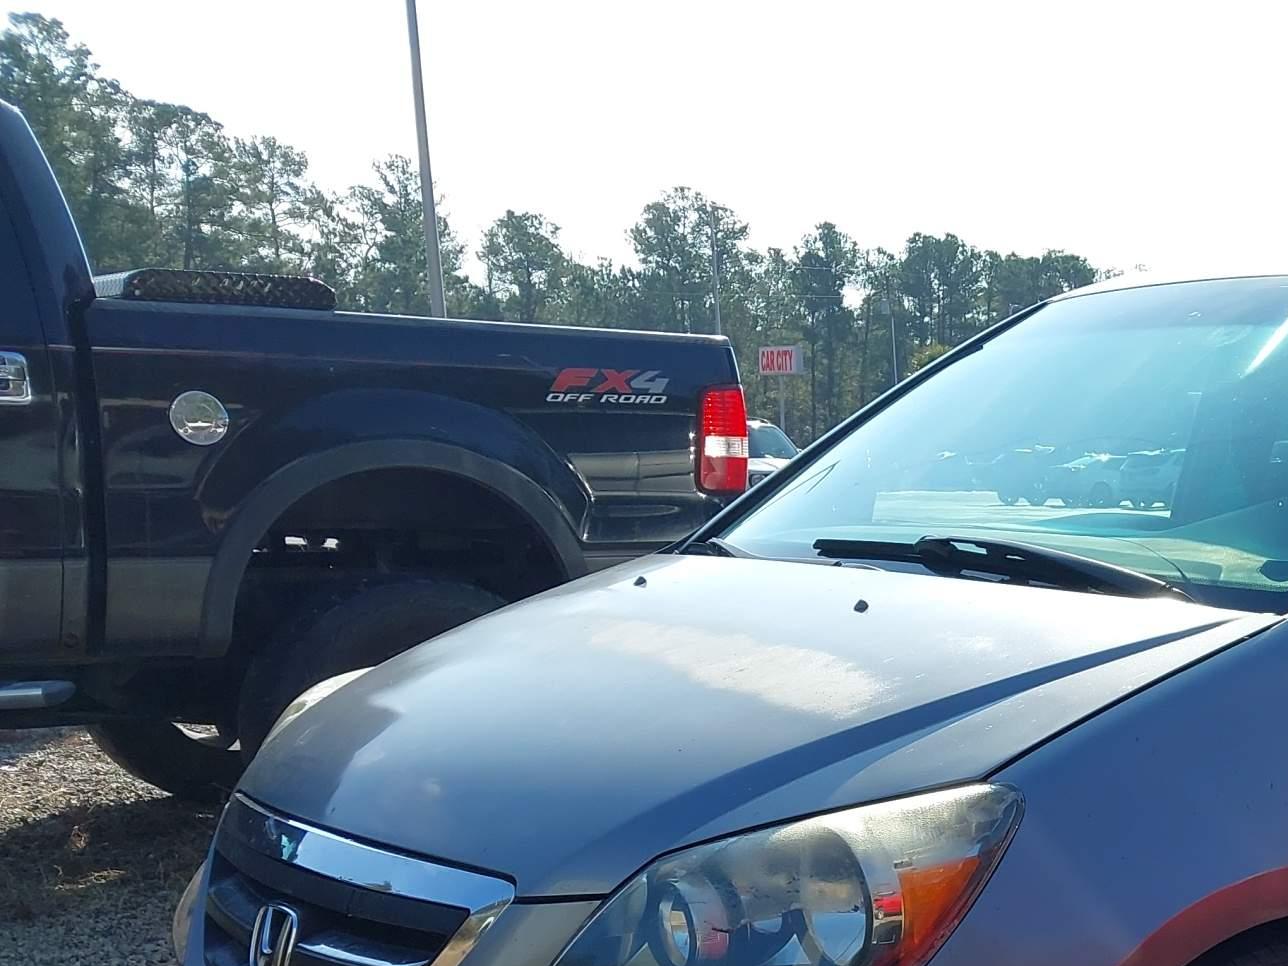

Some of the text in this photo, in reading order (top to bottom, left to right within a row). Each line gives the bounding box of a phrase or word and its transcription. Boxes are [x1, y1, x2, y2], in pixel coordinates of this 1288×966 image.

[761, 350, 792, 371] CAR CITY
[550, 368, 669, 393] FX4
[546, 393, 667, 404] OFF ROAD
